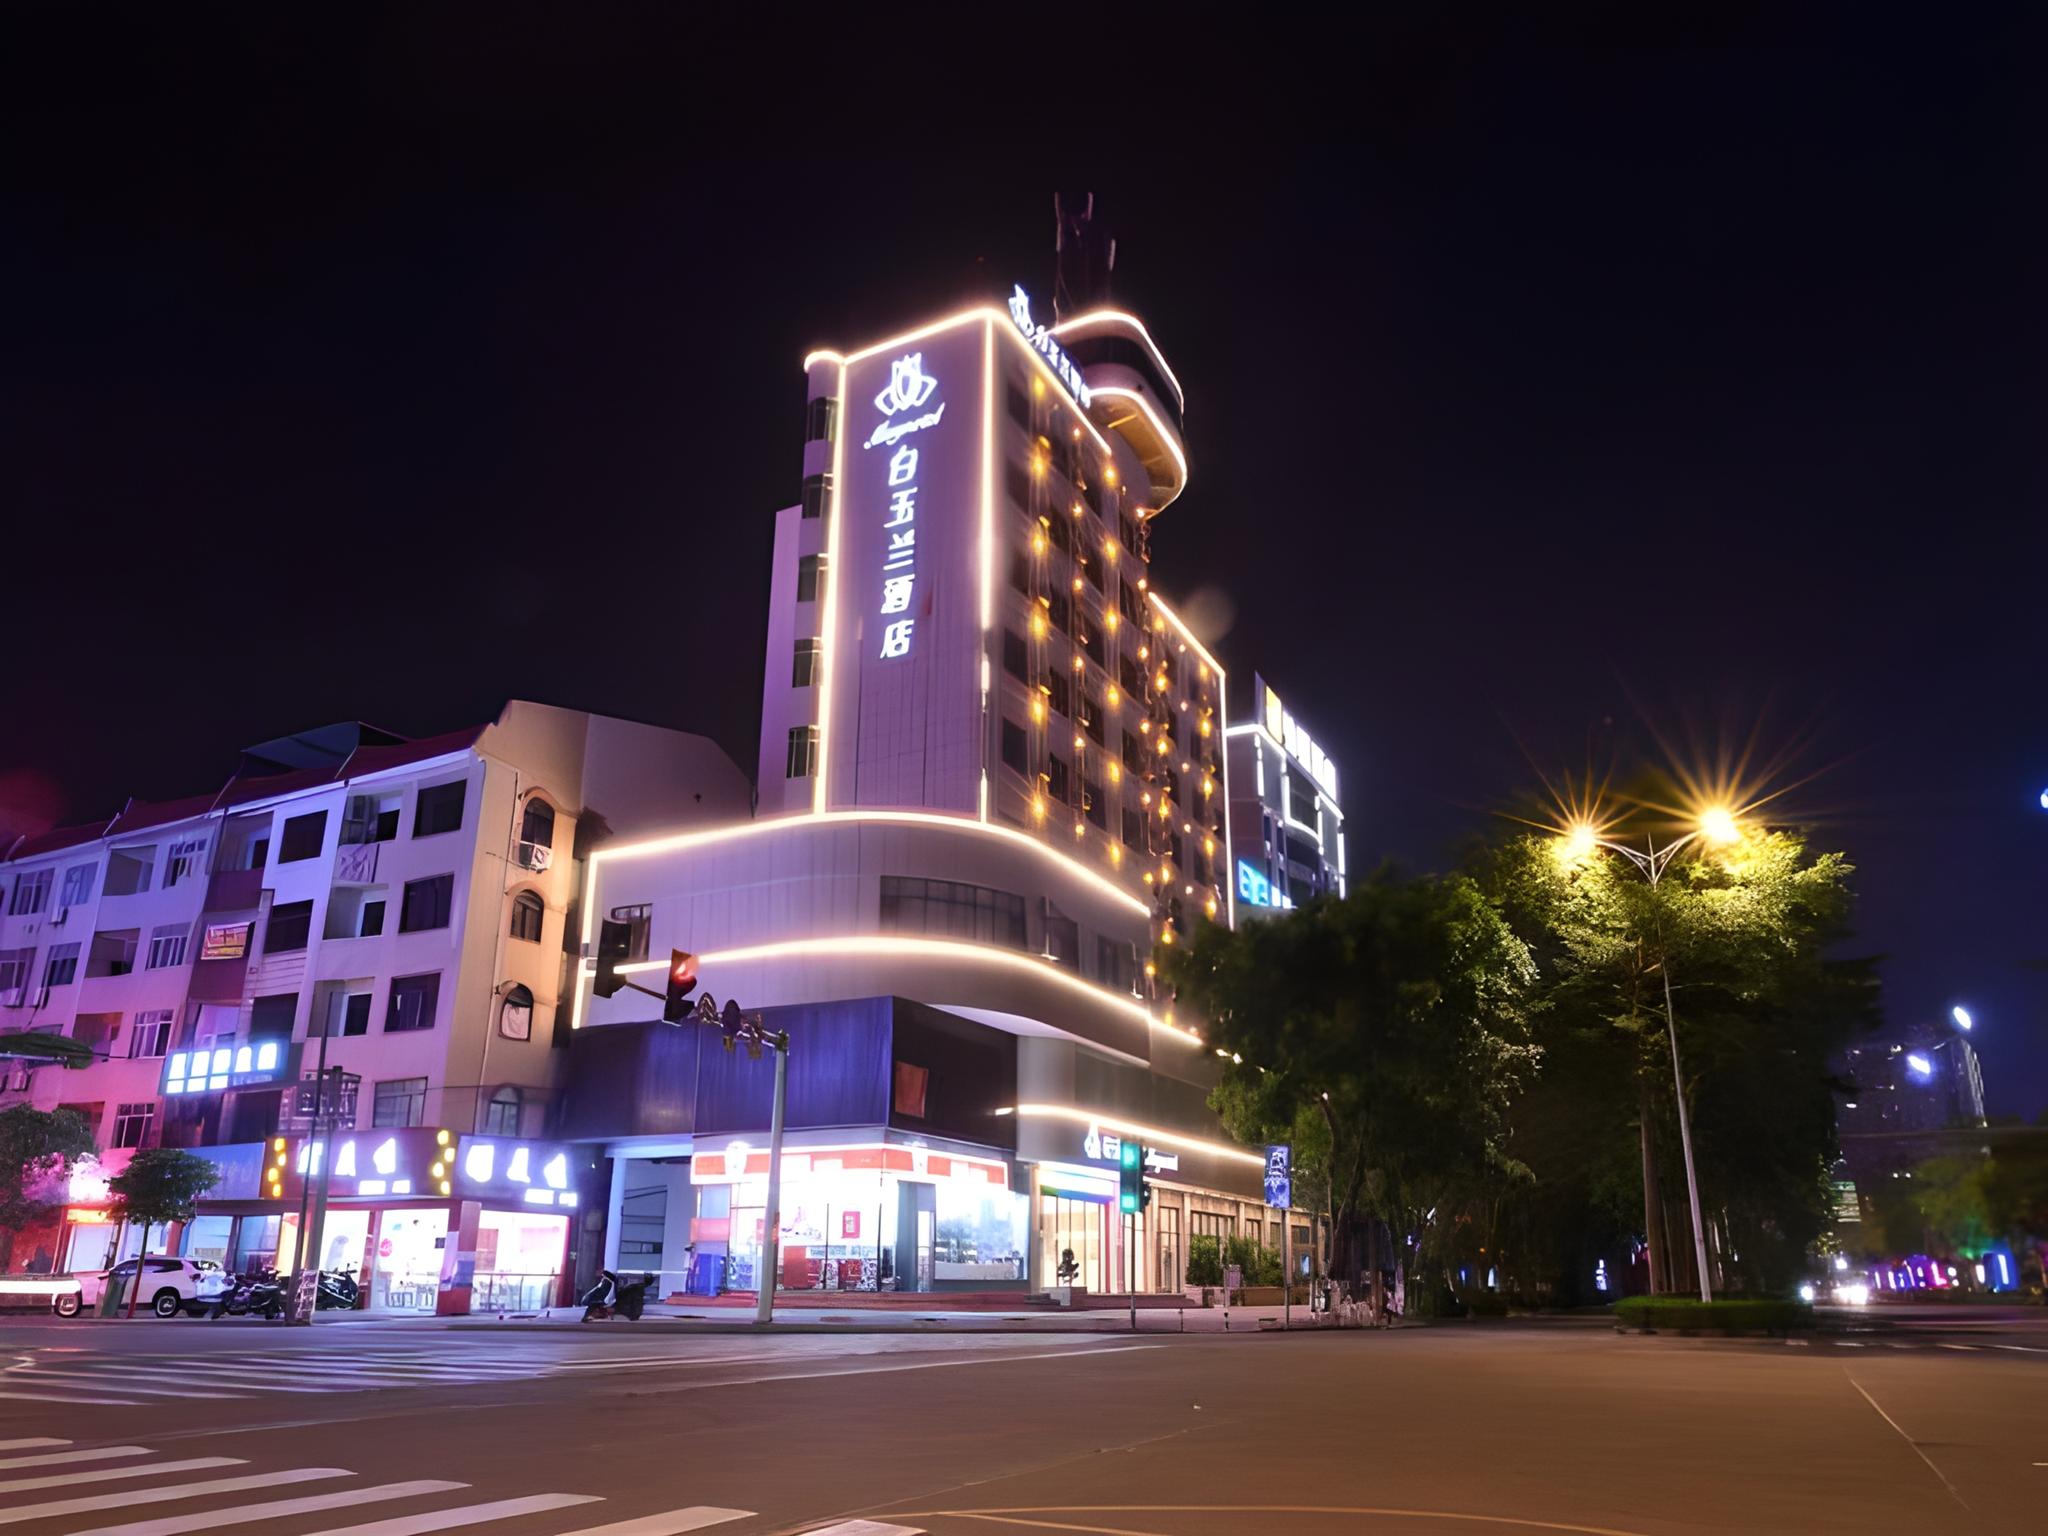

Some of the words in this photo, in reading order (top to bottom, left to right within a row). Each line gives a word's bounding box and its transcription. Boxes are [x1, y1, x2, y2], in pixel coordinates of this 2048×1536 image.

[880, 444, 919, 660] 白玉兰酒店
